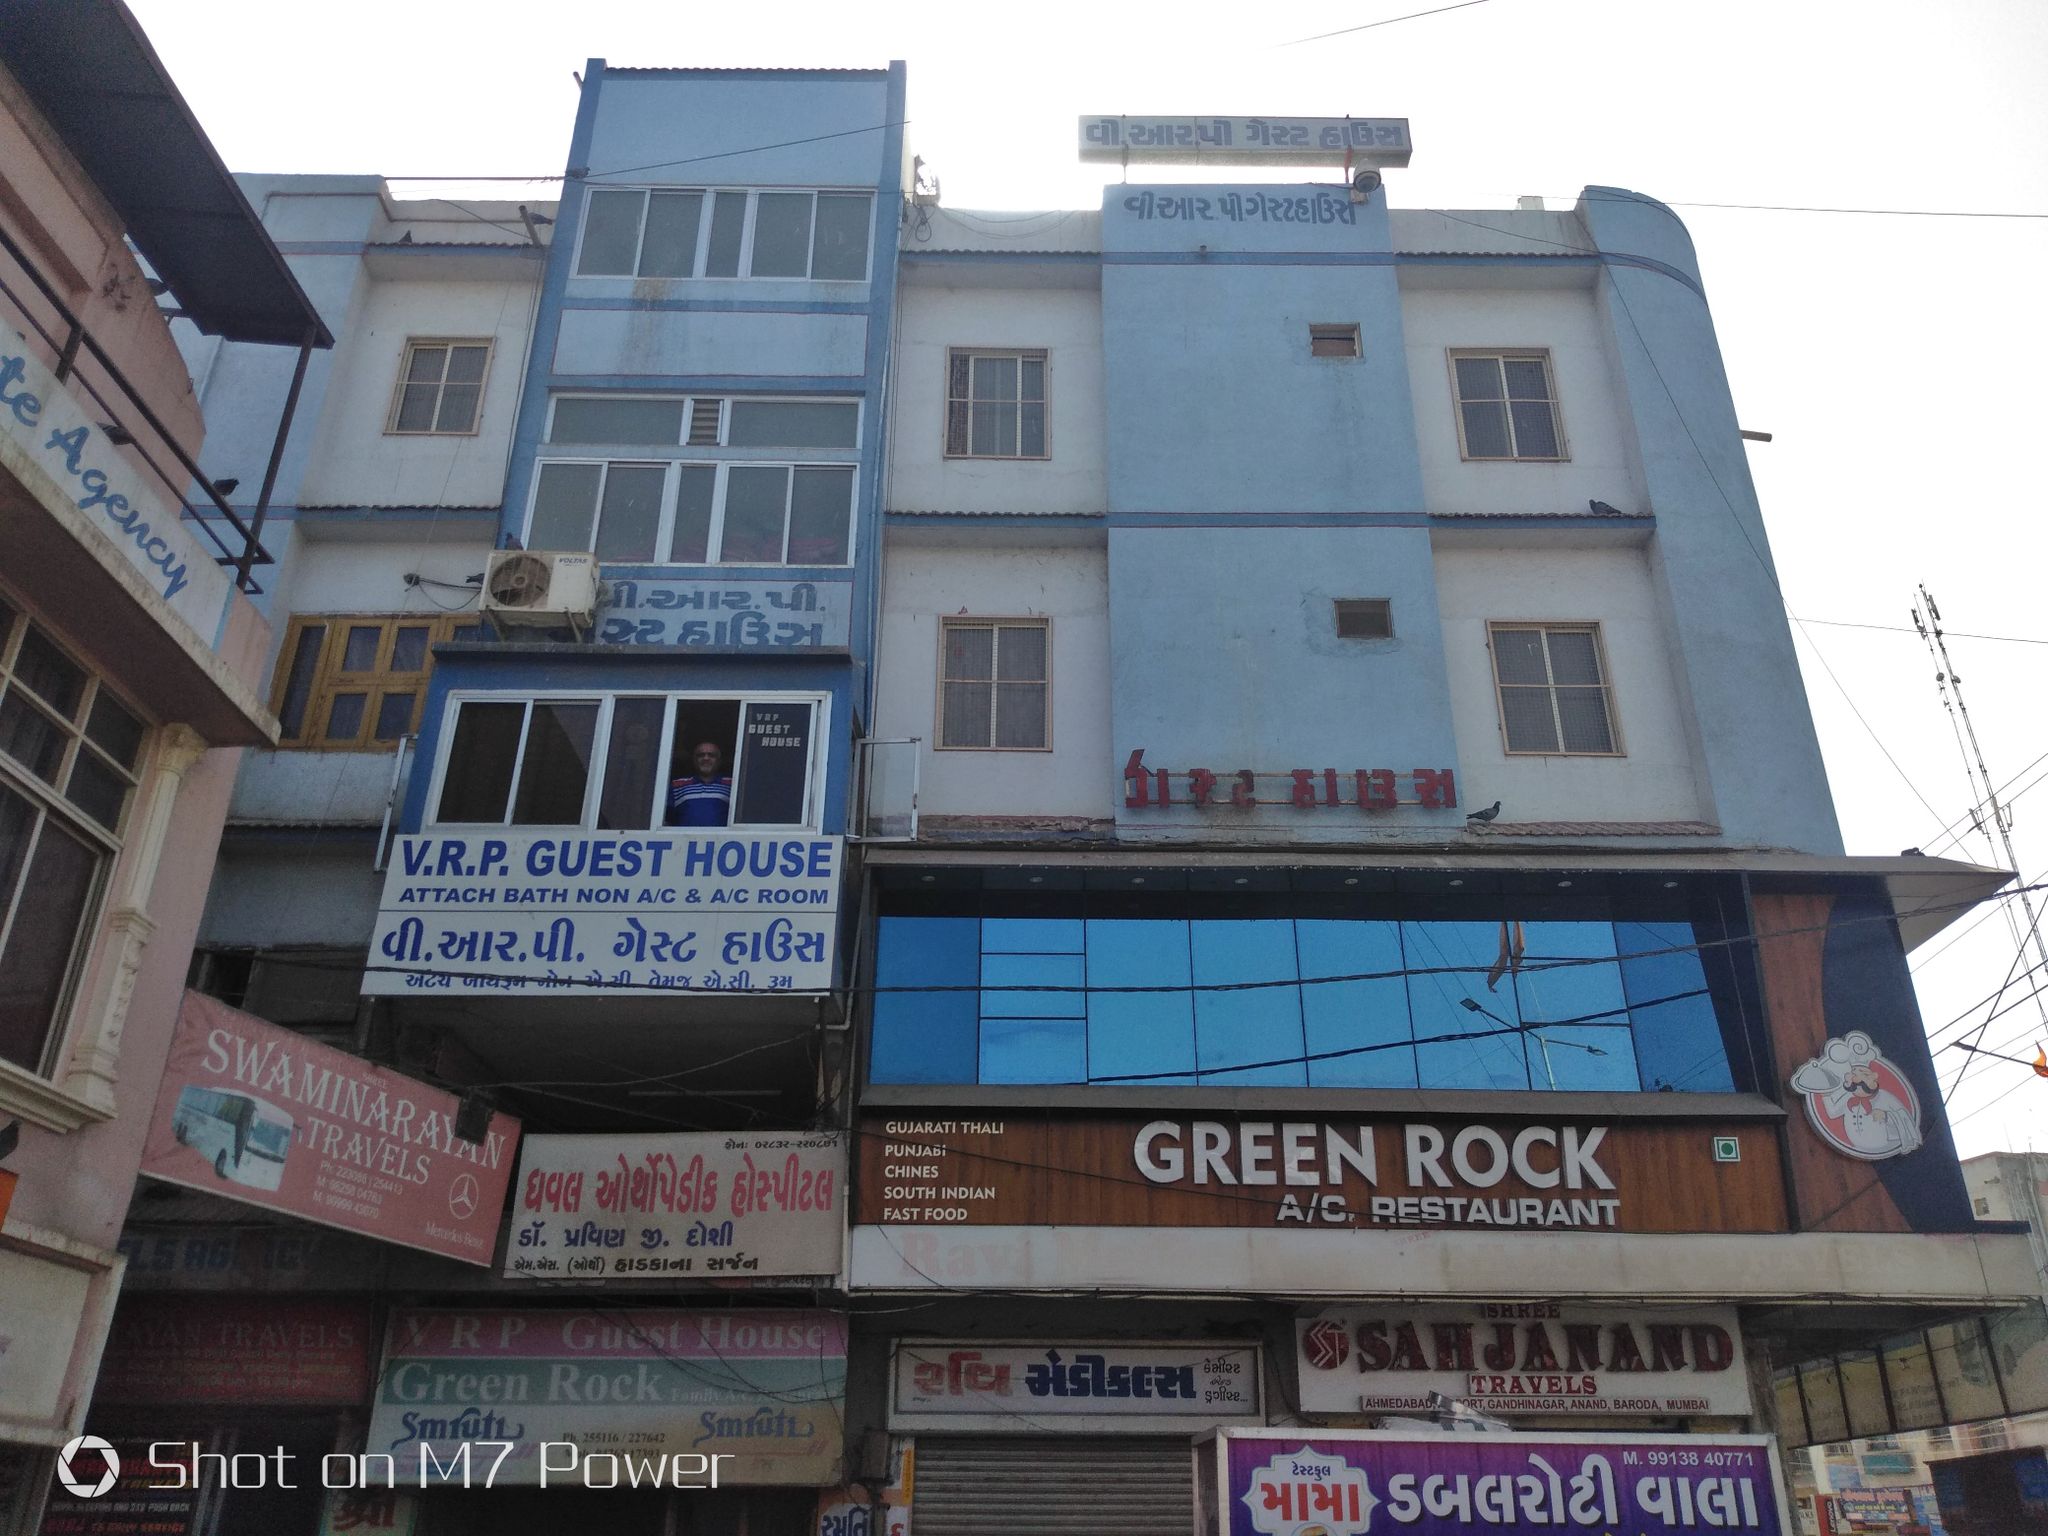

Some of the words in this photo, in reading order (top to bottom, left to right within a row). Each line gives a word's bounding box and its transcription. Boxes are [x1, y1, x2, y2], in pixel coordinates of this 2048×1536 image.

[1246, 119, 1310, 147] ગેસ્ટ
[1318, 121, 1403, 150] હાઉસ
[46, 426, 188, 600] Agency
[677, 610, 823, 646] હાઉસ
[748, 724, 791, 735] GUEST
[761, 737, 801, 747] HOUSE
[402, 839, 509, 877] V.R.P.
[526, 839, 673, 877] GUEST
[684, 840, 833, 878] HOUSE
[399, 888, 495, 903] ATTACH
[503, 888, 568, 903] BATH
[576, 888, 630, 903] NON
[637, 888, 676, 904] A/C
[685, 889, 702, 903] &
[710, 888, 750, 904] A/C
[757, 889, 829, 905] ROOM
[381, 917, 585, 963] વી.આર.પી.
[613, 917, 697, 963] ગેસ્ટ
[721, 918, 826, 966] હાઉસ
[649, 969, 693, 989] તેમજ
[885, 1121, 957, 1135] GUJARATI
[960, 1121, 1005, 1135] THALI
[297, 1116, 433, 1185] TRAVELS
[1133, 1120, 1379, 1187] GREEN
[1404, 1123, 1617, 1191] ROCK
[524, 1166, 584, 1214] ધવલ
[731, 1152, 835, 1217] હોસ્પીટલ
[884, 1165, 940, 1179] CHINES
[883, 1186, 937, 1200] SOUTH
[940, 1186, 997, 1201] INDIAN
[883, 1207, 921, 1221] FAST
[924, 1207, 969, 1221] FOOD
[1371, 1195, 1622, 1227] RESTAURANT
[563, 1220, 626, 1248] પ્રવિણ
[640, 1226, 671, 1250] જી.
[685, 1220, 735, 1248] દોશી
[614, 1256, 692, 1272] હાડકાના
[706, 1252, 760, 1271] સર્જન
[1487, 1303, 1561, 1320] SHREE
[562, 1316, 684, 1351] Guest
[694, 1316, 824, 1352] House
[1358, 1321, 1735, 1374] SAHJANAND
[391, 1361, 530, 1402] Green
[547, 1362, 663, 1403] Rock
[913, 1351, 1014, 1396] રવિ
[1471, 1376, 1598, 1395] TRAVELS
[1488, 1398, 1569, 1411] GANDHINAGAR,
[1571, 1399, 1611, 1411] ANAND,
[1613, 1399, 1663, 1411] BARODA,
[1666, 1400, 1710, 1410] MUMBAI
[1623, 1451, 1644, 1466] M.
[1647, 1451, 1699, 1467] 99138
[1704, 1451, 1755, 1467] 40771
[1260, 1483, 1361, 1522] મામા
[1387, 1452, 1619, 1526] ડબલરોટી
[1635, 1476, 1760, 1528] વાલા
